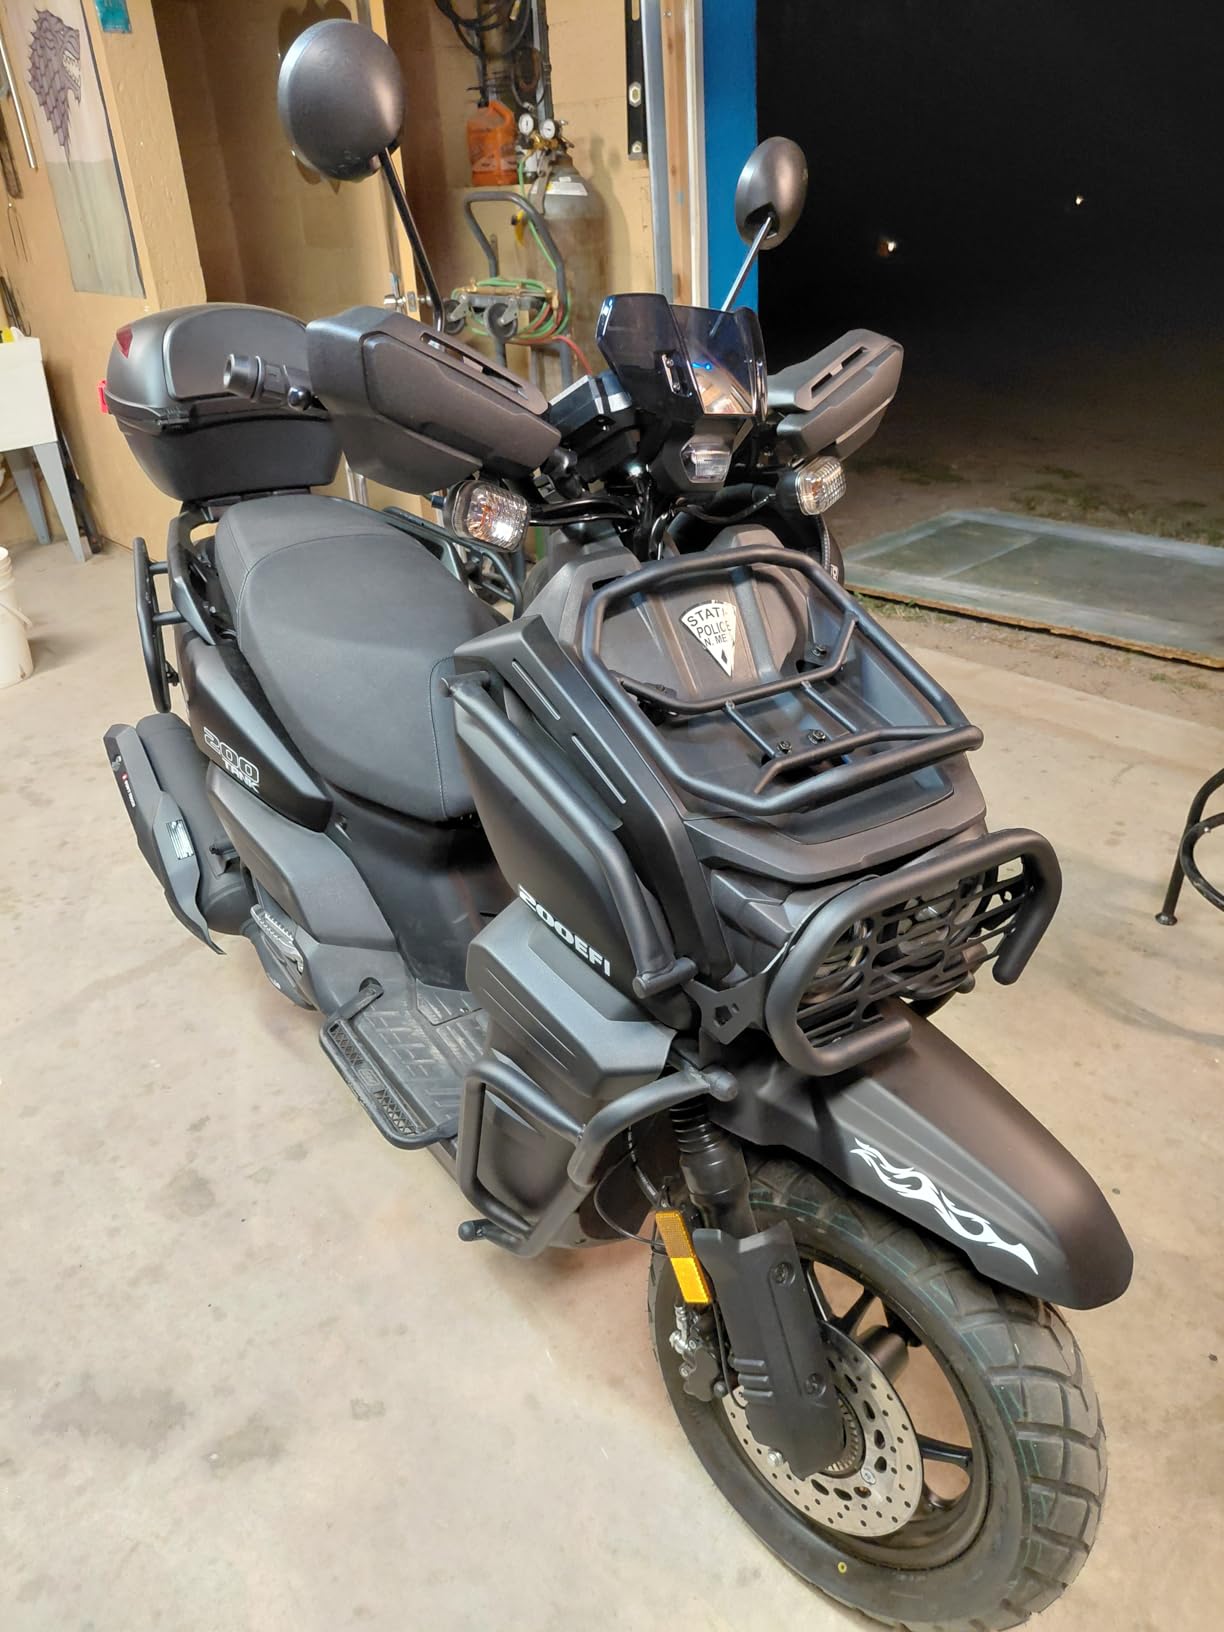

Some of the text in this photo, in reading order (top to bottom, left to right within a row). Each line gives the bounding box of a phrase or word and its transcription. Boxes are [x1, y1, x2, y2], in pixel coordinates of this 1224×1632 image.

[696, 620, 732, 638] POLICE
[203, 726, 260, 783] 200
[222, 757, 260, 793] TANK
[518, 883, 611, 977] 200EFI
